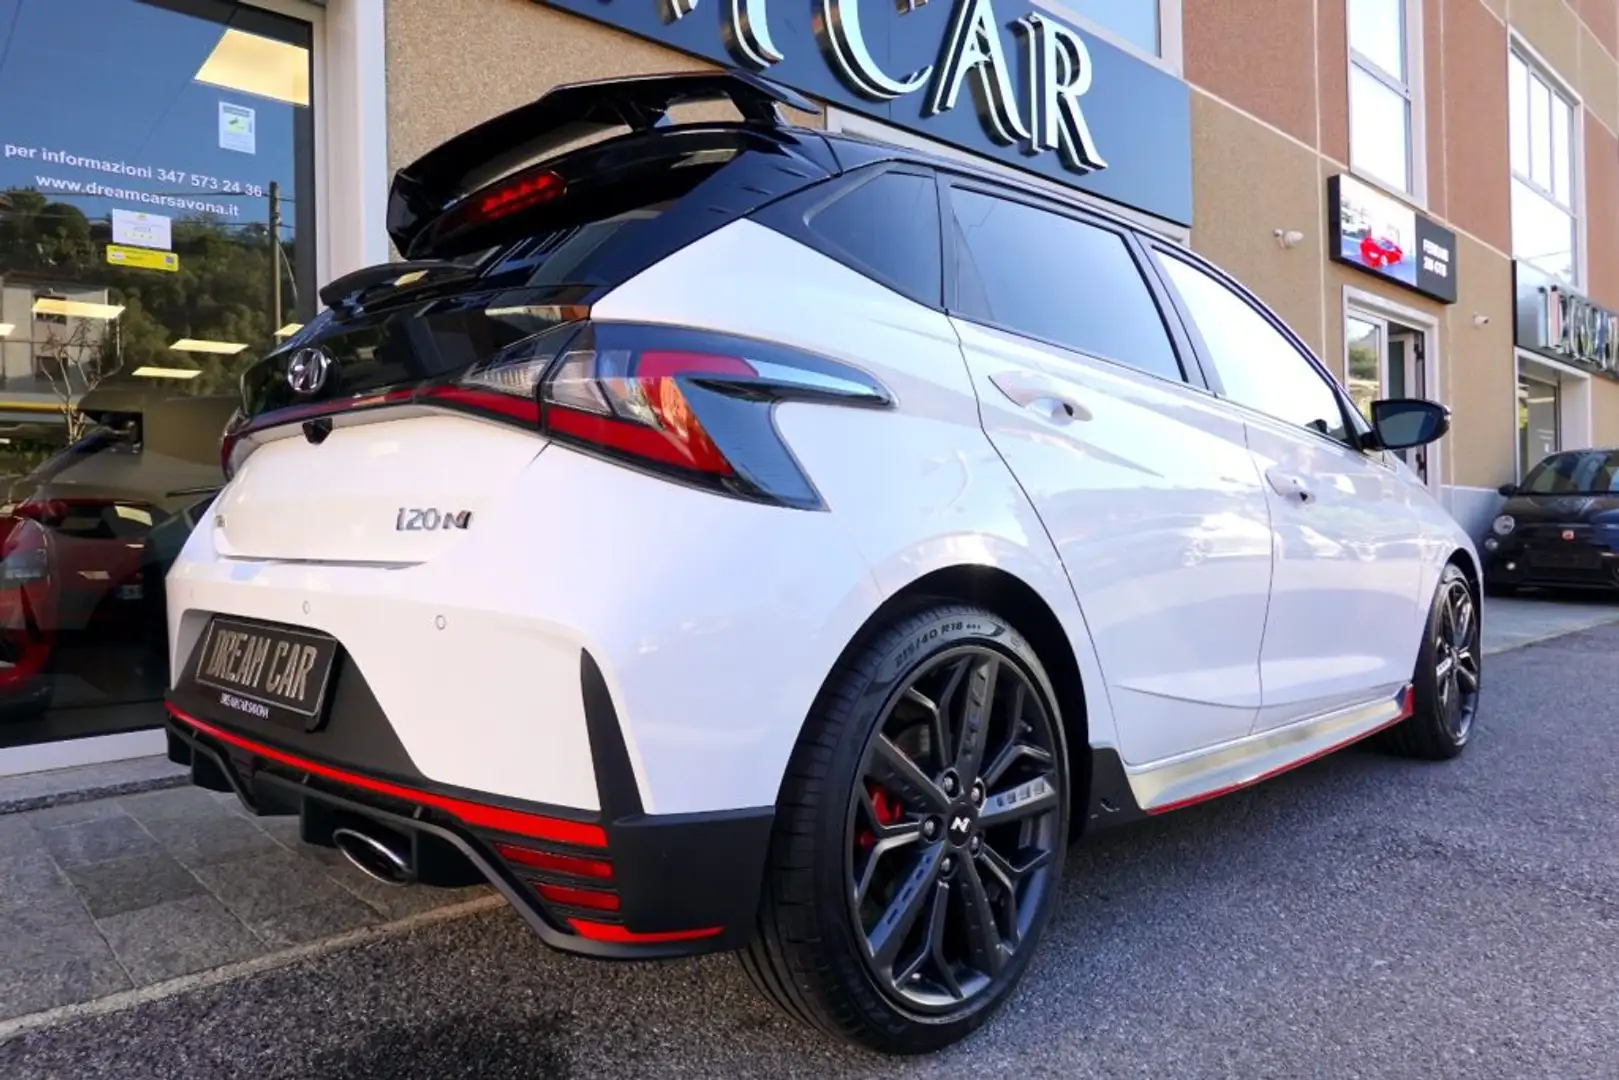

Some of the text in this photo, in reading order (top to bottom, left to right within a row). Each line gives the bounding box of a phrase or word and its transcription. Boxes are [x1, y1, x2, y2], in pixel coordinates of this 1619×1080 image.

[4, 143, 264, 198] per informazioni 347 573 24 36
[35, 174, 240, 217] www.dreamcarsavona.it
[206, 629, 317, 702] DREAM CAR
